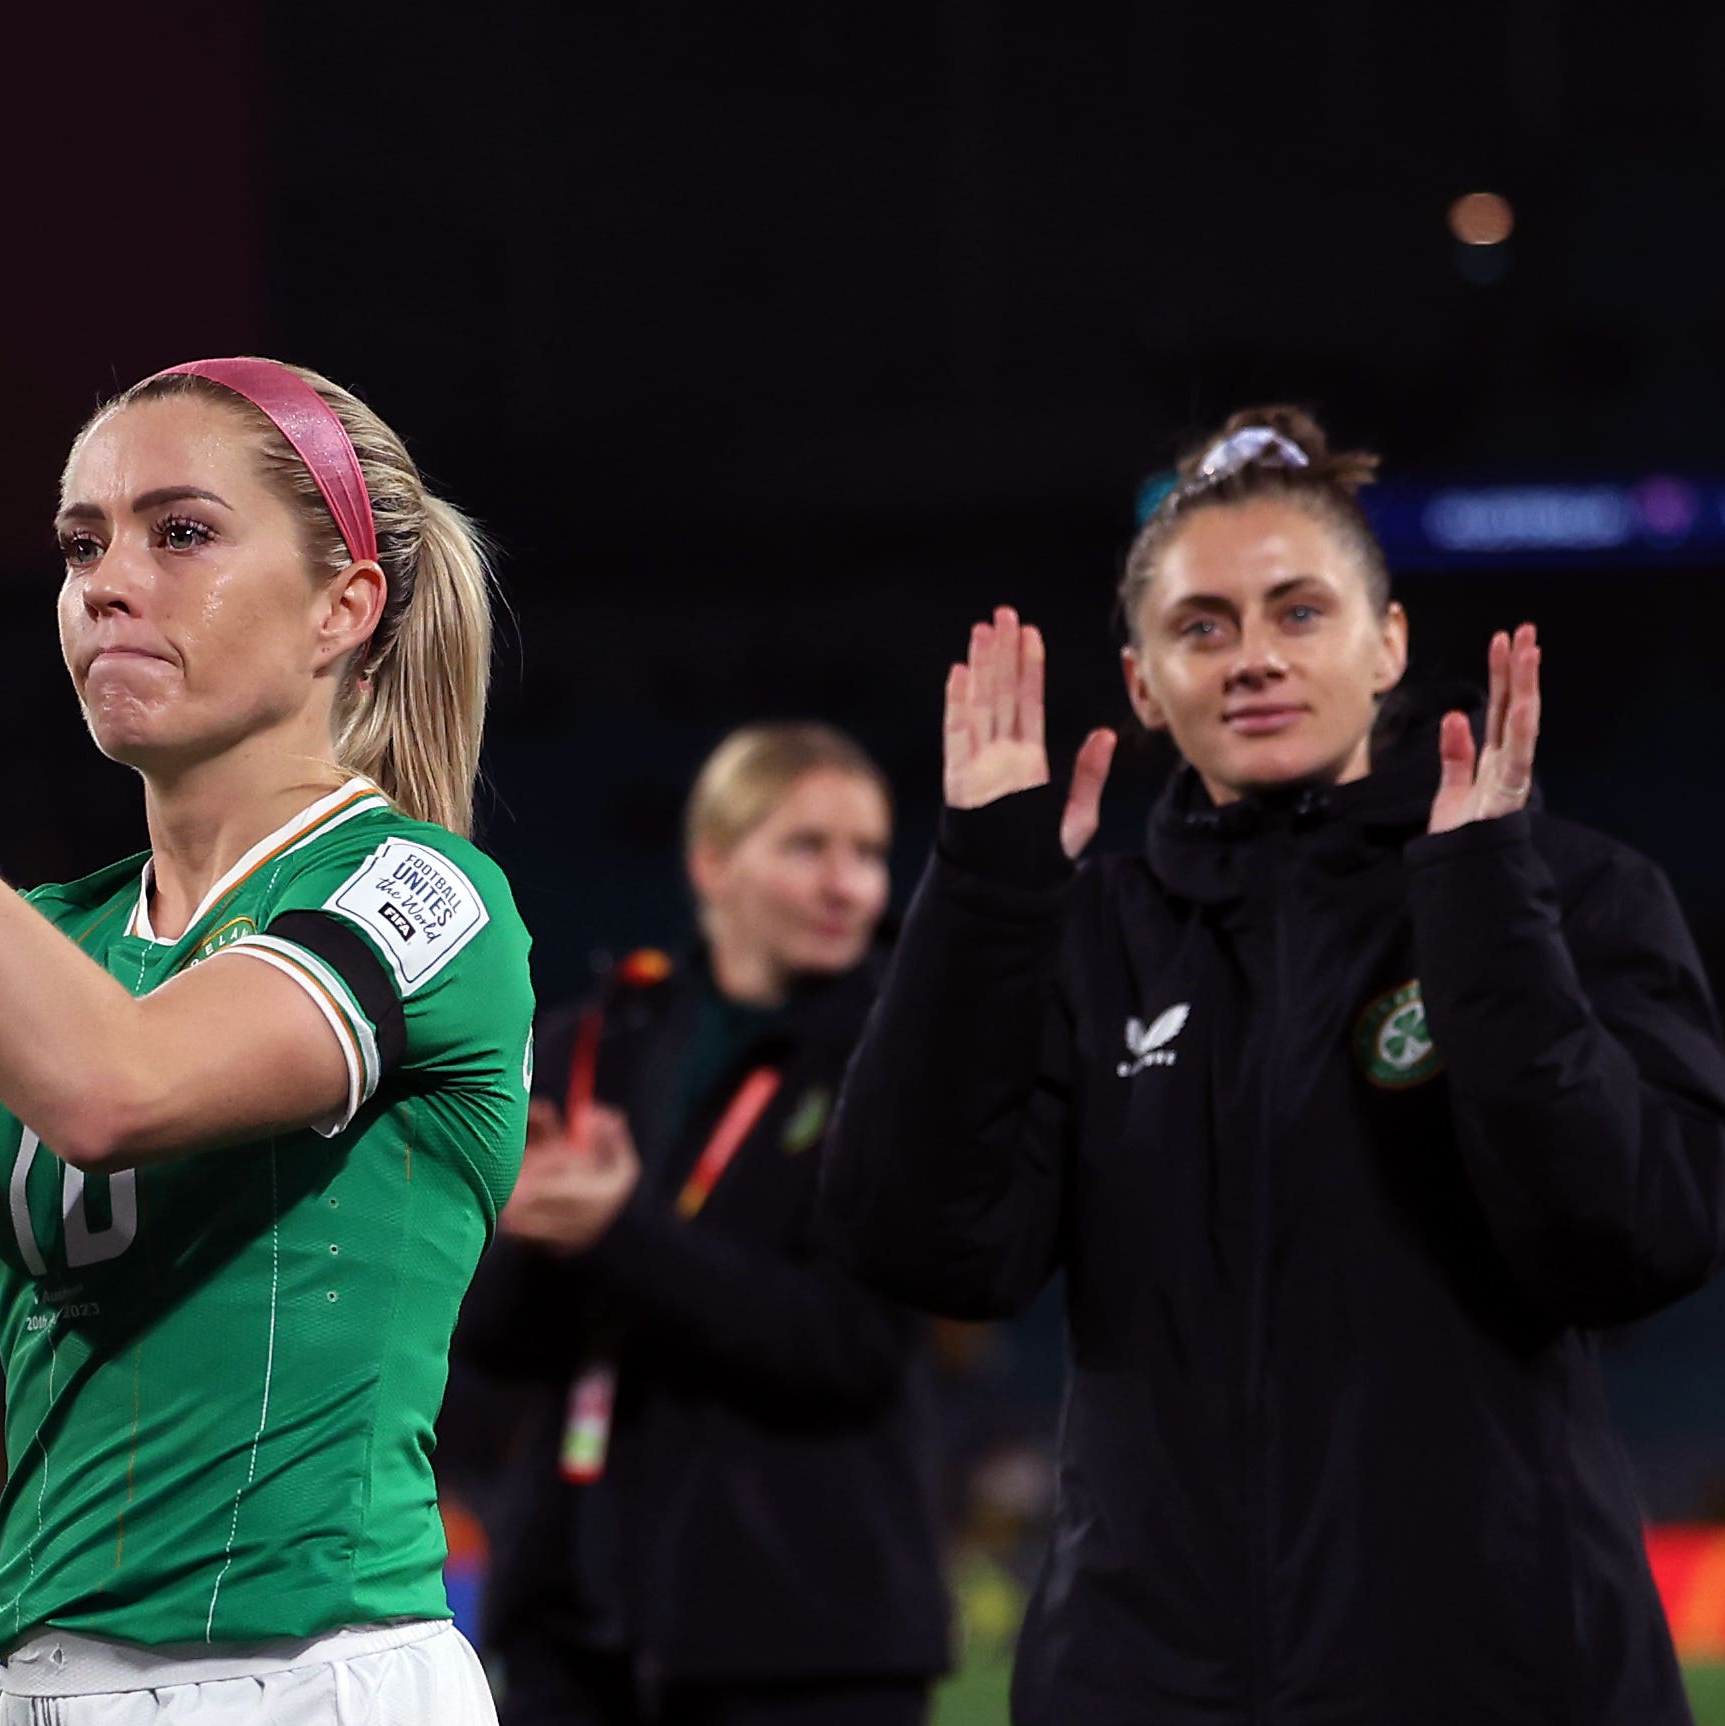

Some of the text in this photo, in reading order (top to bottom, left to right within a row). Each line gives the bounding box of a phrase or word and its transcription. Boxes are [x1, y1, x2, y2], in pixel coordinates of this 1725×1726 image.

[375, 876, 441, 945] the World
[392, 861, 453, 928] UNITES
[405, 853, 462, 914] FOOTBALL
[383, 907, 412, 938] FIFA
[62, 1302, 101, 1320] 2023
